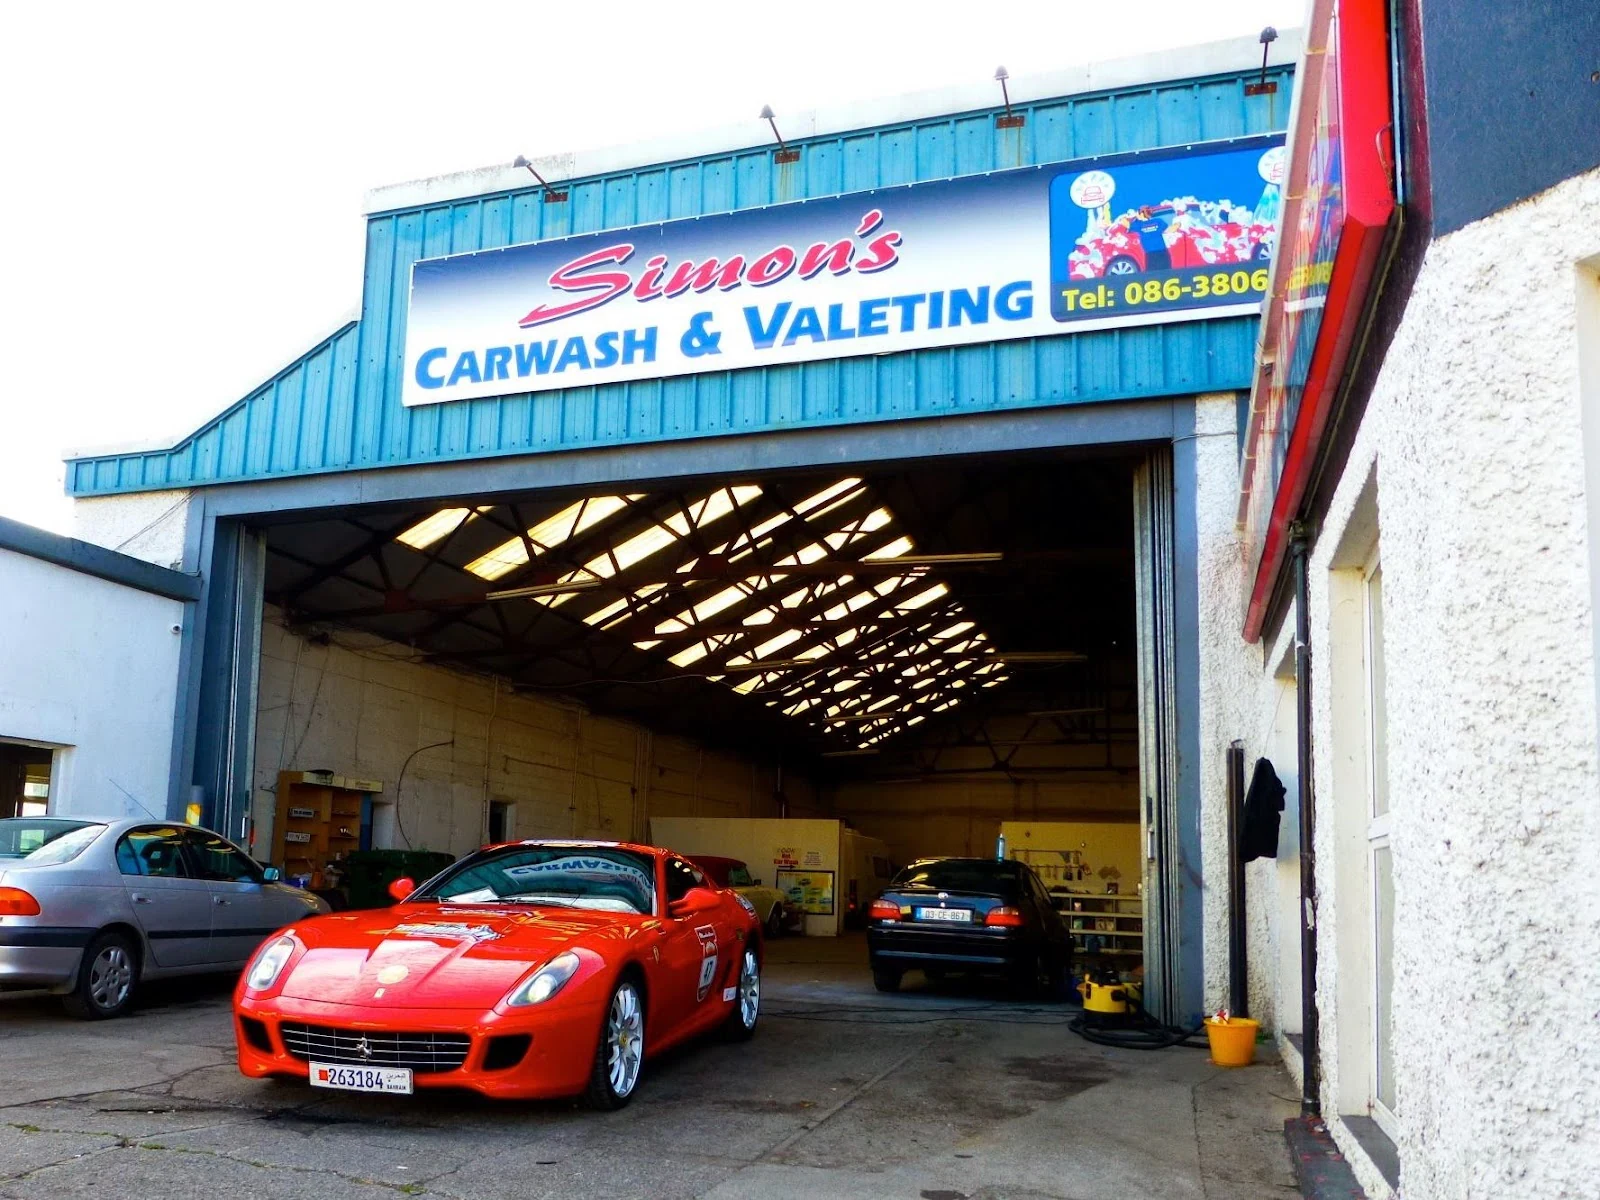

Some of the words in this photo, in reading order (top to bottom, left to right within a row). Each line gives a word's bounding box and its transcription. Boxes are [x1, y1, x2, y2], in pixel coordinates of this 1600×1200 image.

[518, 208, 903, 328] Simon's
[1062, 285, 1115, 311] Tel:
[414, 326, 658, 390] CARWASH
[680, 311, 722, 358] &
[743, 280, 1033, 350] VALETING
[924, 909, 966, 921] 03-CE-867
[328, 1067, 384, 1090] 263184
